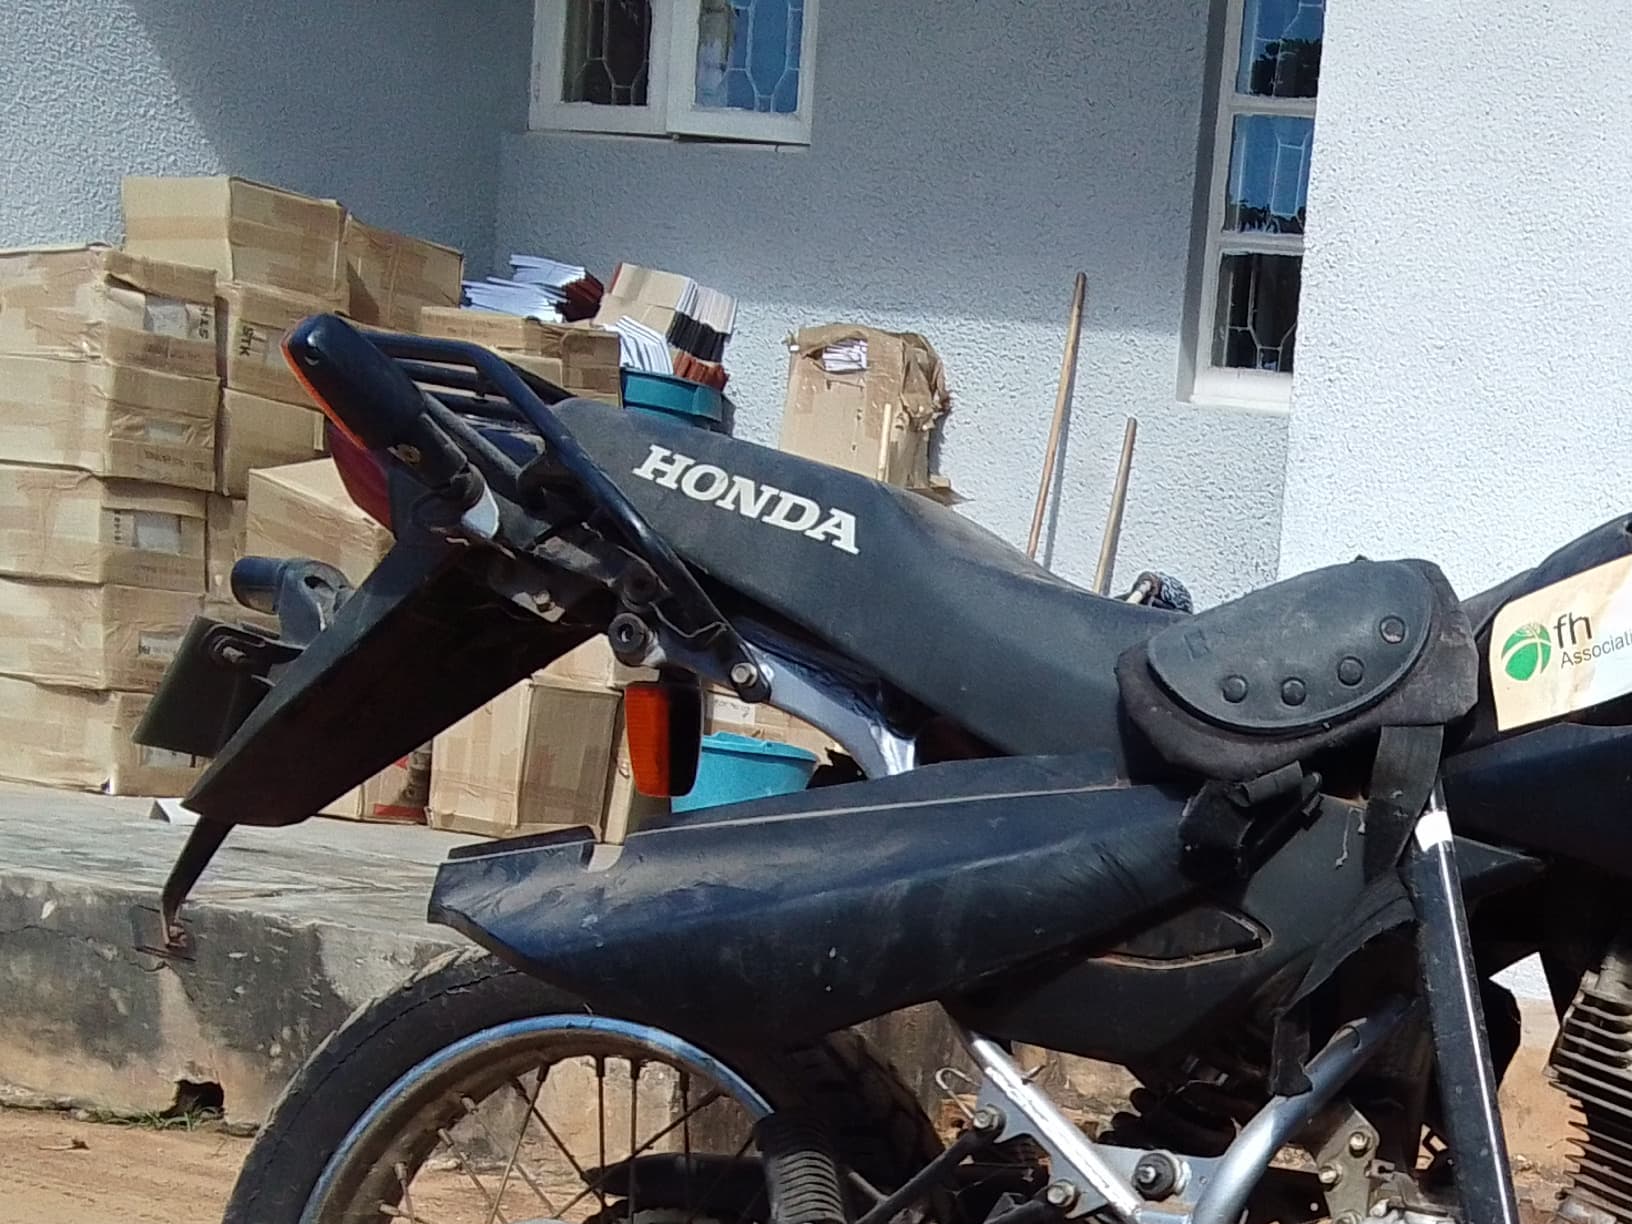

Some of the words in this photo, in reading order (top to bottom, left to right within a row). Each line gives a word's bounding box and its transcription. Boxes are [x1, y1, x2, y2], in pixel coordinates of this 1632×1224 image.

[239, 326, 256, 357] STK
[632, 444, 861, 555] HONDA
[1553, 612, 1592, 649] fh
